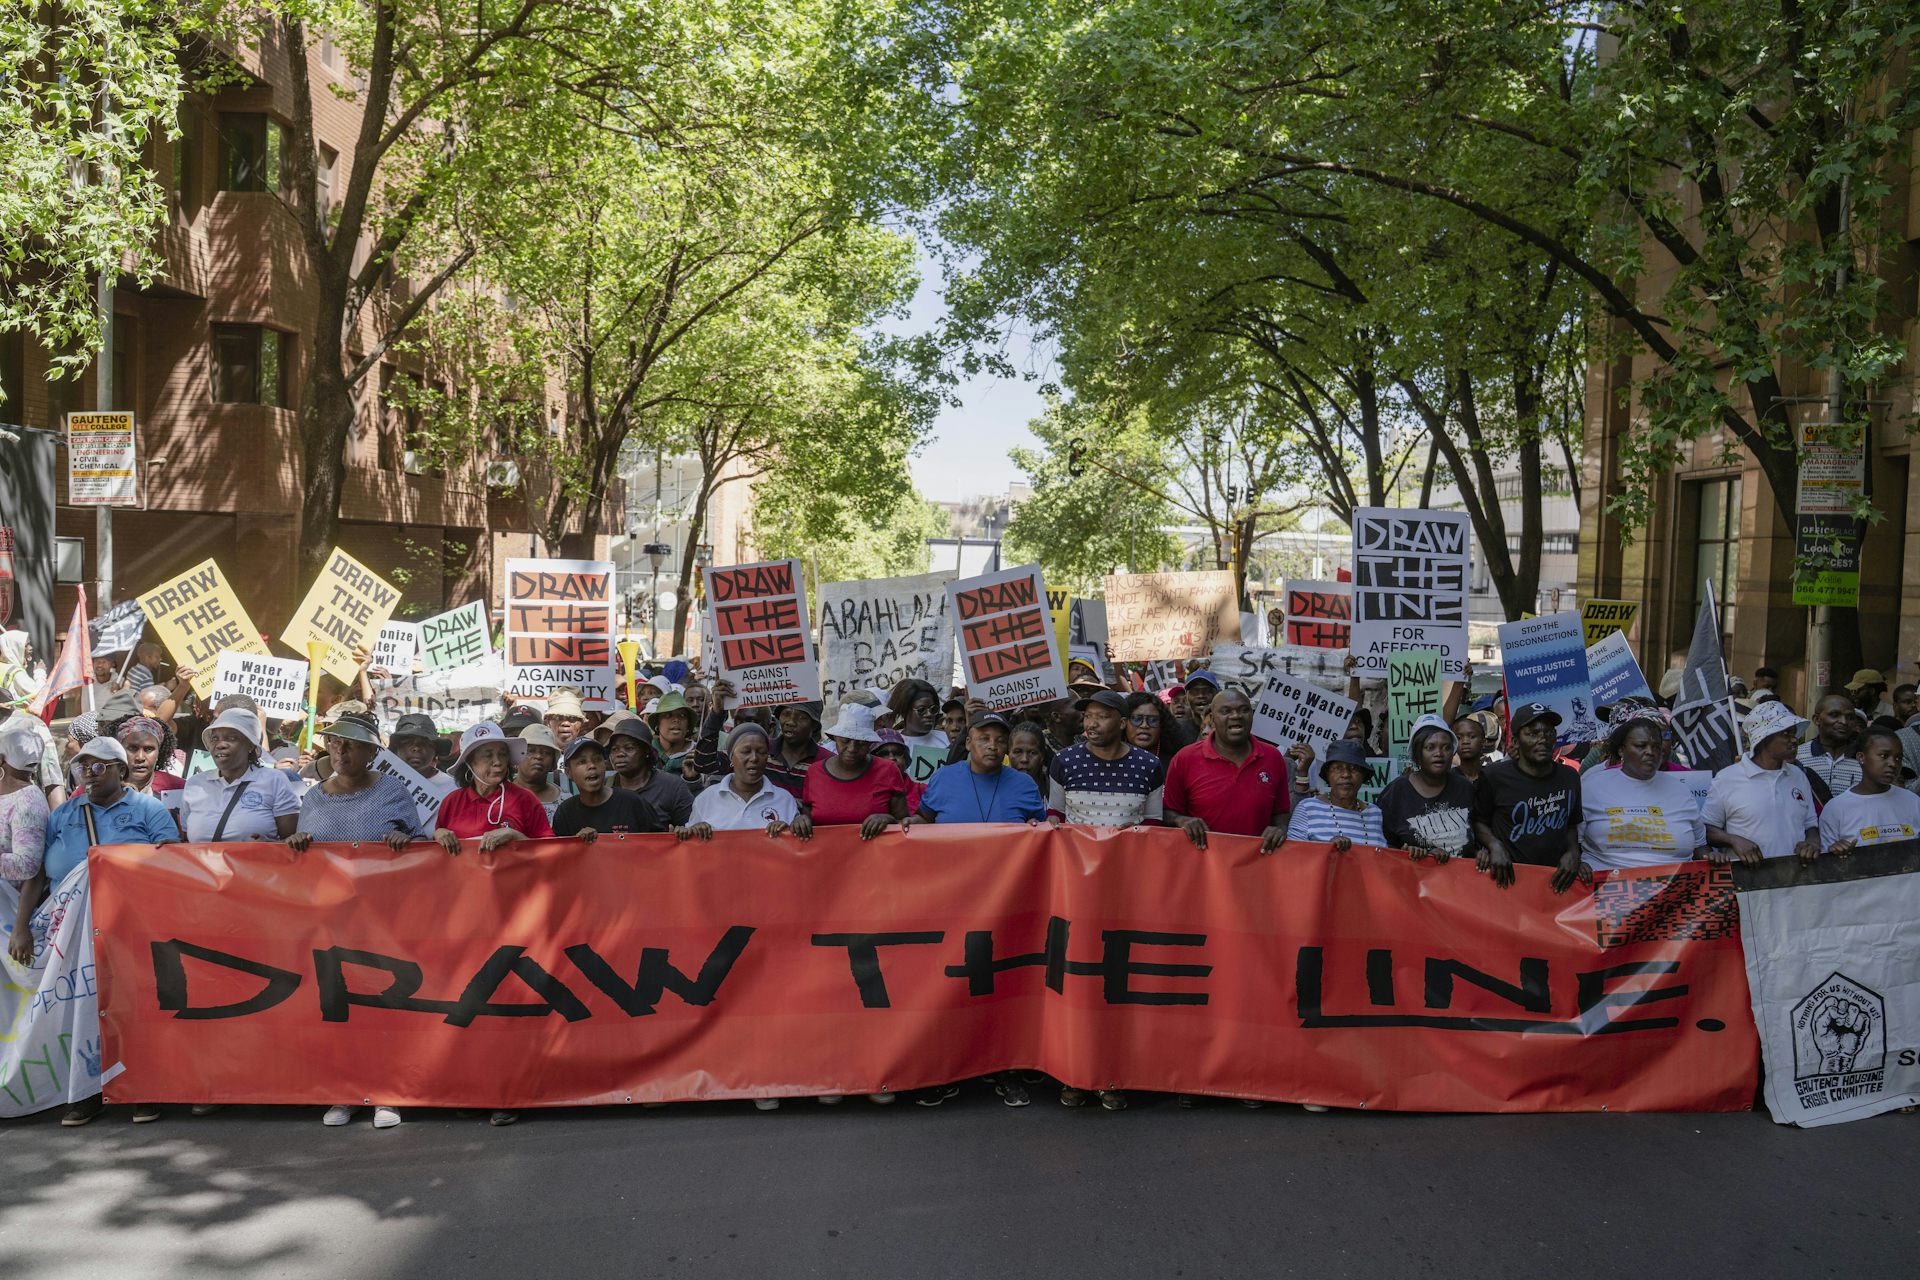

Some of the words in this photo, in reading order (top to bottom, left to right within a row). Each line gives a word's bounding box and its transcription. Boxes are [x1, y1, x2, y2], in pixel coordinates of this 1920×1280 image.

[72, 415, 128, 424] GAUTENG
[1360, 518, 1463, 553] DRAW
[330, 555, 396, 608] DRAW
[512, 571, 610, 600] DRAW
[710, 561, 792, 601] DRAW
[1359, 556, 1462, 590] THE
[146, 566, 218, 619] DRAW
[330, 584, 374, 627] THE
[955, 574, 1035, 620] DRAW
[1290, 590, 1351, 620] DRA
[173, 597, 226, 636] THE
[512, 604, 609, 632] THE
[716, 599, 797, 634] THE
[1359, 592, 1462, 626] LINE
[1584, 604, 1637, 620] DRAW
[310, 606, 363, 650] LINE
[422, 604, 478, 645] DRAW
[963, 608, 1041, 649] THE
[1393, 628, 1424, 640] FOR
[1521, 623, 1542, 635] STOP
[1543, 621, 1559, 631] THE
[186, 620, 245, 665] LINE
[378, 641, 396, 653] ter
[426, 629, 481, 666] THE
[512, 636, 609, 666] LINE
[722, 633, 804, 671] LINE
[854, 626, 938, 674] BASE
[1506, 628, 1578, 650] DISCONNECTIONS
[1594, 646, 1608, 656] THE
[242, 660, 282, 676] Water
[337, 651, 347, 661] No
[968, 640, 1051, 684] LINE
[1356, 656, 1463, 672] COMIES
[1514, 666, 1542, 678] WATER
[1544, 659, 1576, 672] JUSTICE
[1588, 646, 1625, 671] NNECTIONS
[224, 671, 244, 682] for
[249, 674, 296, 691] People
[517, 668, 595, 682] AGAINST
[742, 667, 789, 681] AGAINST
[746, 679, 792, 694] CLIMATE
[1390, 659, 1438, 688] DRAW
[1536, 674, 1558, 684] NOW
[1591, 686, 1605, 696] TER
[1605, 670, 1631, 688] JUSTICE
[238, 684, 277, 698] before
[510, 685, 608, 699] AUSTITY
[743, 692, 800, 707] INJUSTICE
[986, 687, 1057, 710] ORRUPTION
[988, 677, 1040, 697] AGAINST
[1267, 676, 1302, 701] Free
[1306, 691, 1352, 720] Water
[1601, 688, 1618, 701] NOW
[1294, 703, 1314, 719] for
[1391, 689, 1438, 715] THE
[1260, 703, 1296, 726] Basic
[1300, 719, 1338, 742] Needs
[1280, 725, 1312, 744] Now!
[411, 786, 440, 812] Fall
[150, 926, 757, 1027] DRAW
[811, 916, 1214, 1008] THE
[1797, 1000, 1815, 1030] NOTHING
[1812, 989, 1828, 1002] FOR
[1842, 986, 1872, 1007] WITHOUT
[1795, 1077, 1839, 1096] GAUTENG
[1842, 1071, 1884, 1087] HOUSING
[1799, 1090, 1829, 1109] CRISIS
[1830, 1082, 1884, 1102] COMMITTEE
